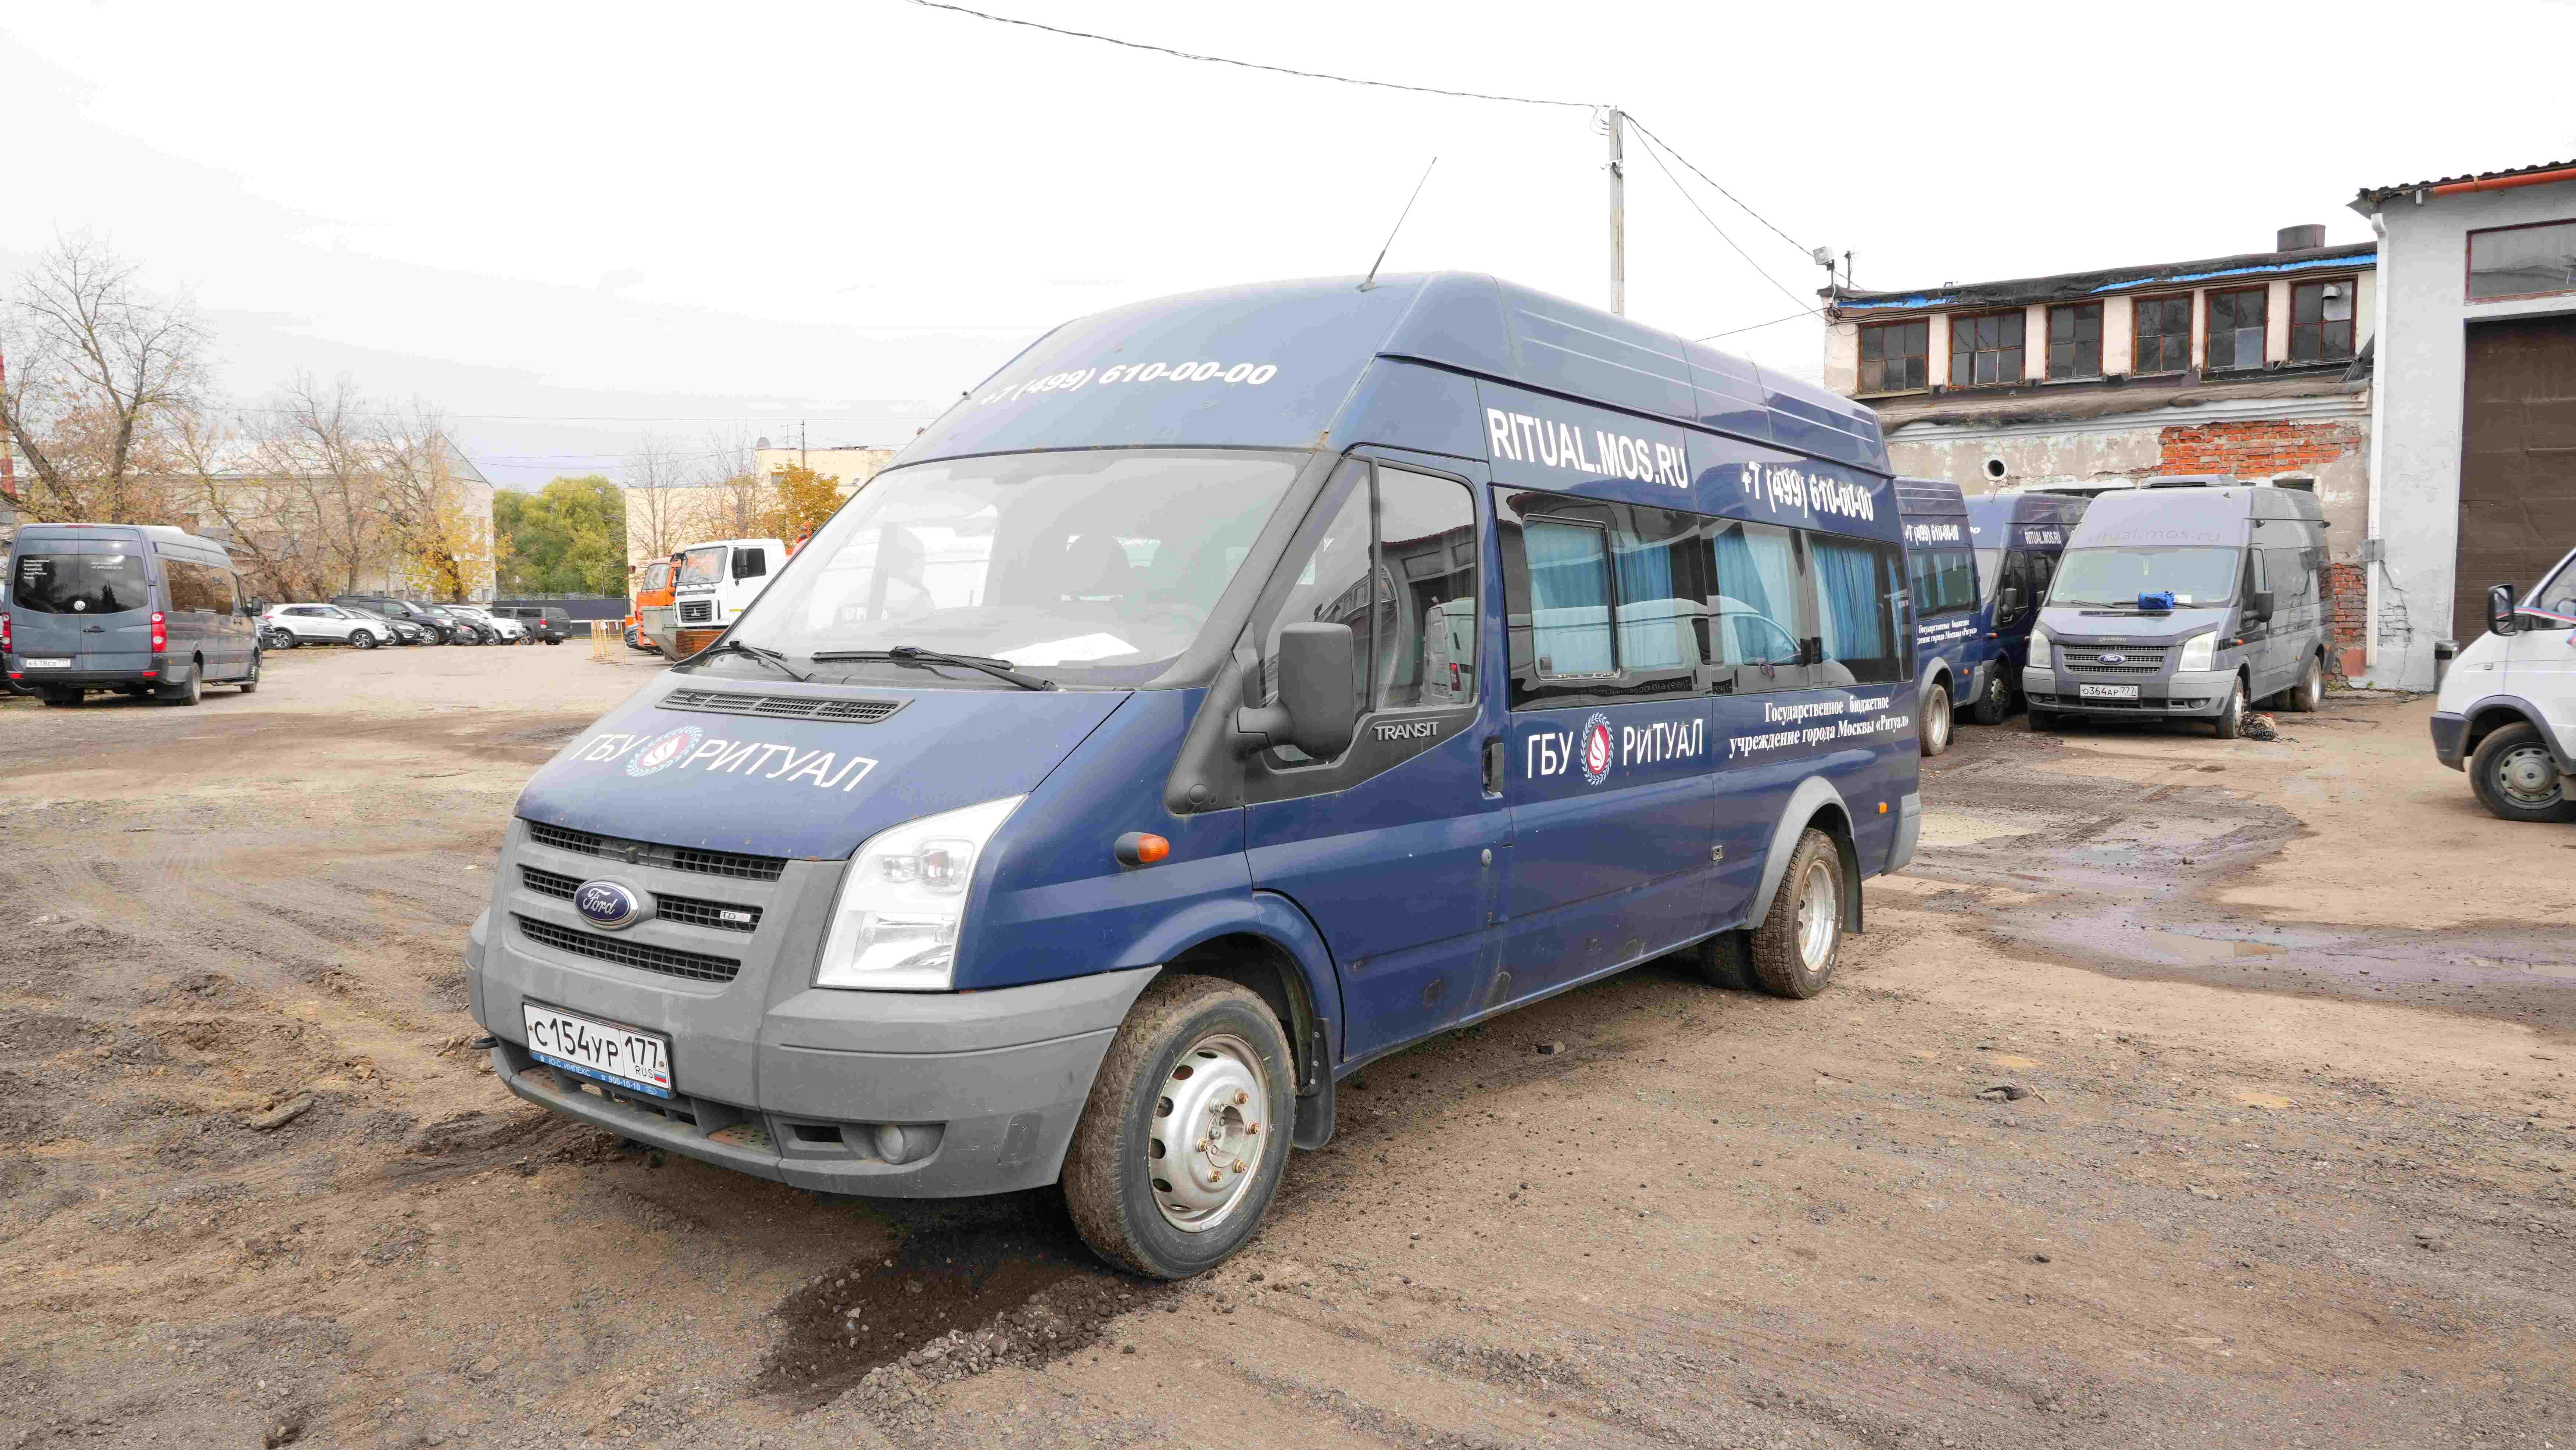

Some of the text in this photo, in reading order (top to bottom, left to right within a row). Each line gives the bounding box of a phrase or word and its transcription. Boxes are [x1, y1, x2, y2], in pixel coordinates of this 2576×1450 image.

[981, 362, 1277, 405] +7 (499) 610-00-00
[1487, 408, 1688, 489] RITUAL.MOS.RU
[1742, 461, 1874, 521] +7 (499) 610-00-00
[1914, 524, 1931, 546] (499)
[2025, 531, 2061, 544] RITUAL.MOS.RU
[1765, 696, 1889, 725] Государственное бюджетное
[1374, 722, 1439, 742] TRANSIT
[1729, 715, 1909, 759] учреждение города Москвы «Ритуал»
[569, 734, 879, 792] ГБУ РИТУАЛ
[1527, 719, 1703, 779] ГБУ РИТУАЛ
[582, 888, 618, 915] Ford
[548, 1057, 591, 1076] Ю.С. ИМПЕКС
[625, 1036, 658, 1068] 177
[608, 1075, 641, 1091] 900-10-10
[635, 1065, 653, 1079] RUS
